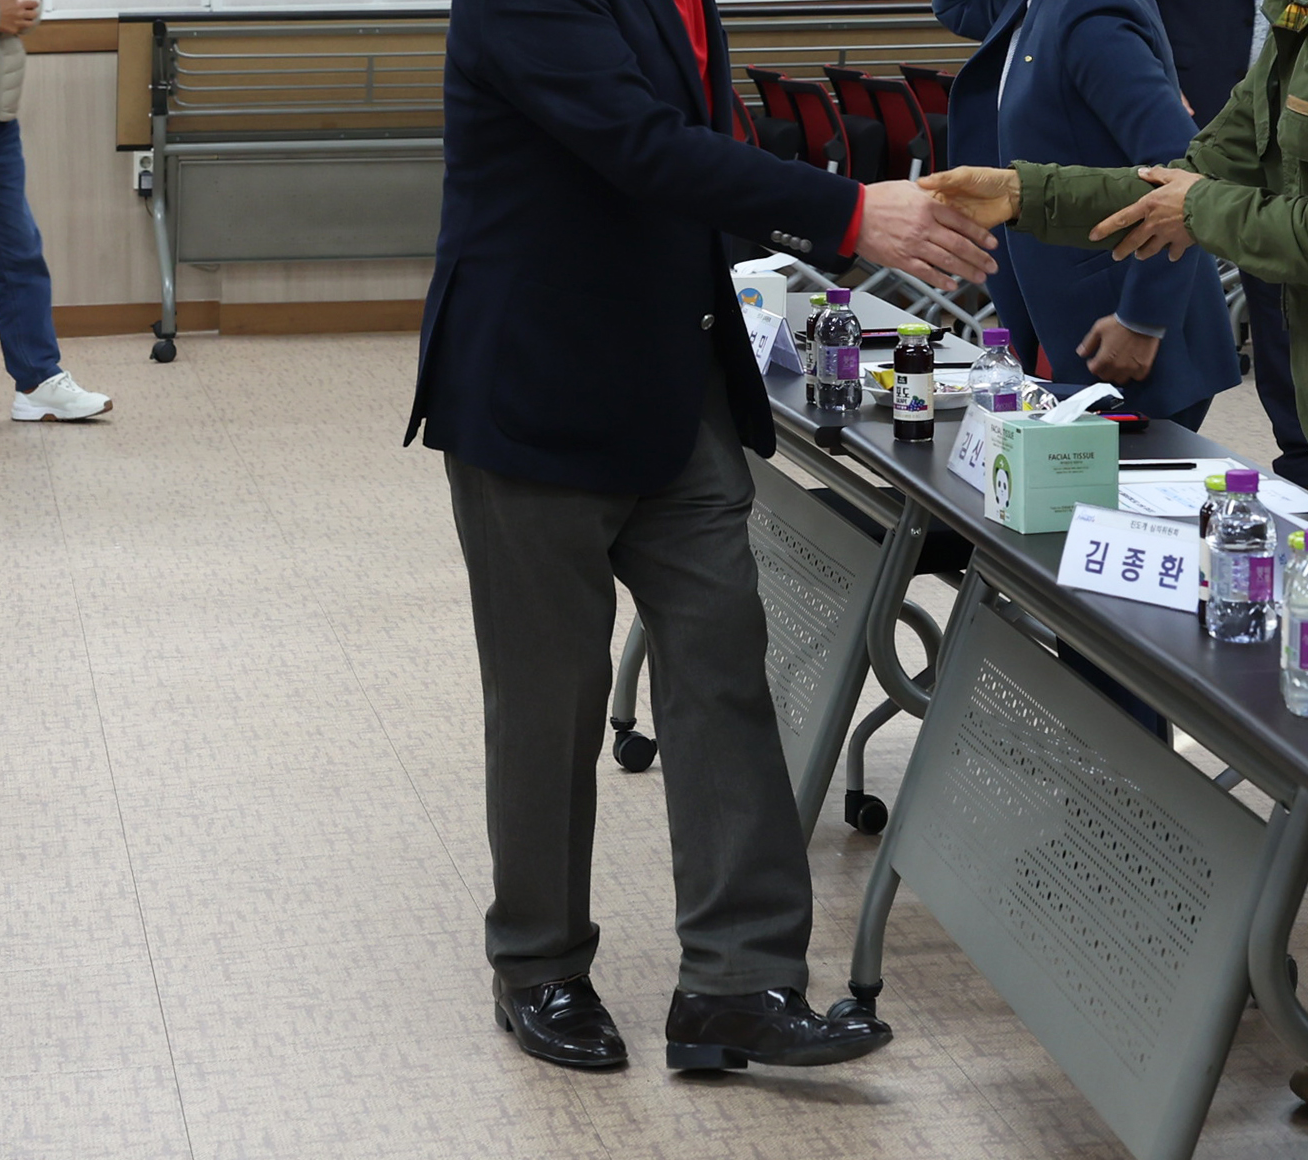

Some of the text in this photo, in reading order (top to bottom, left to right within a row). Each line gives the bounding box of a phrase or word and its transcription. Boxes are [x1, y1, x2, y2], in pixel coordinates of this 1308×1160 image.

[958, 432, 985, 472] 김신
[1048, 452, 1095, 461] FACIAL TISSUE
